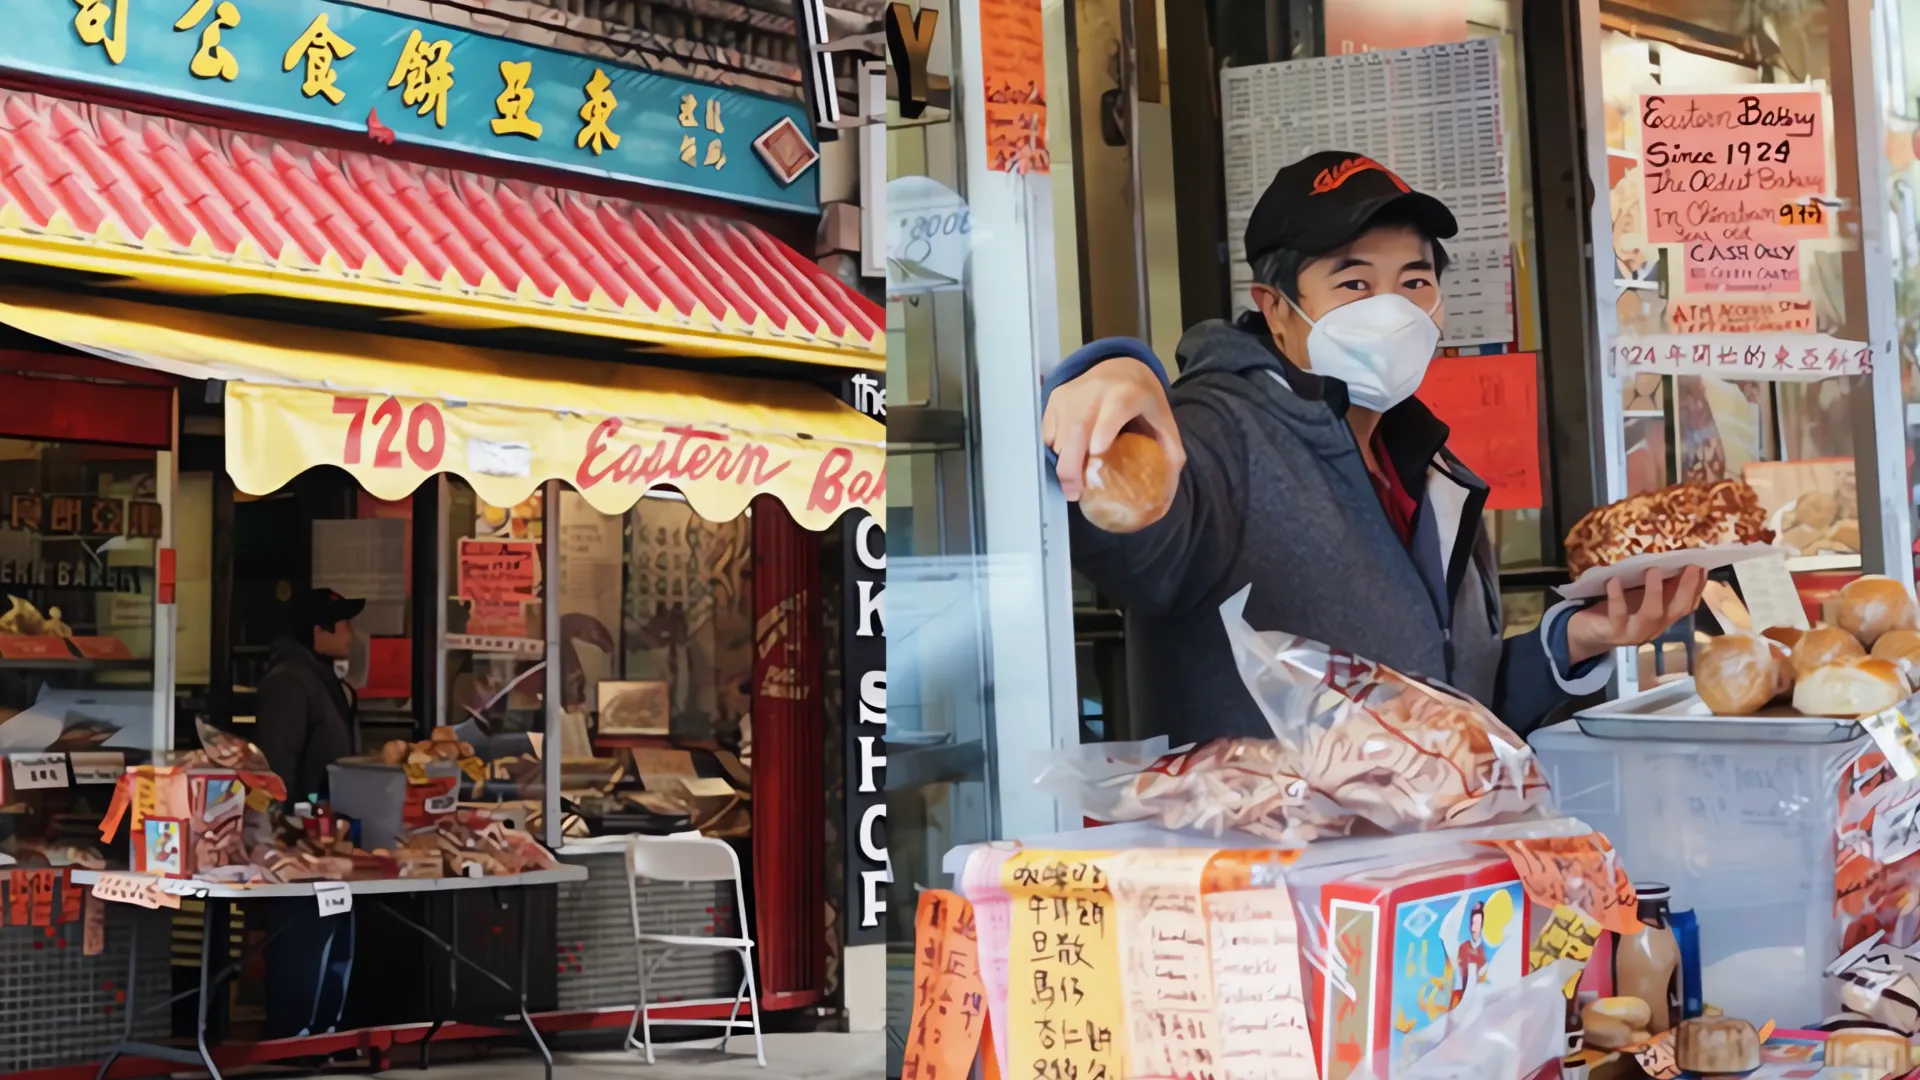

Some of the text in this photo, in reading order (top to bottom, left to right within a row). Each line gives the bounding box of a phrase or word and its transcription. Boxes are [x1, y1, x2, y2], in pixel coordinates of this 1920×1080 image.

[887, 2, 940, 106] Y
[1644, 168, 1686, 194] The
[1646, 142, 1717, 167] Since
[332, 396, 446, 472] 720
[575, 416, 791, 490] Eastern
